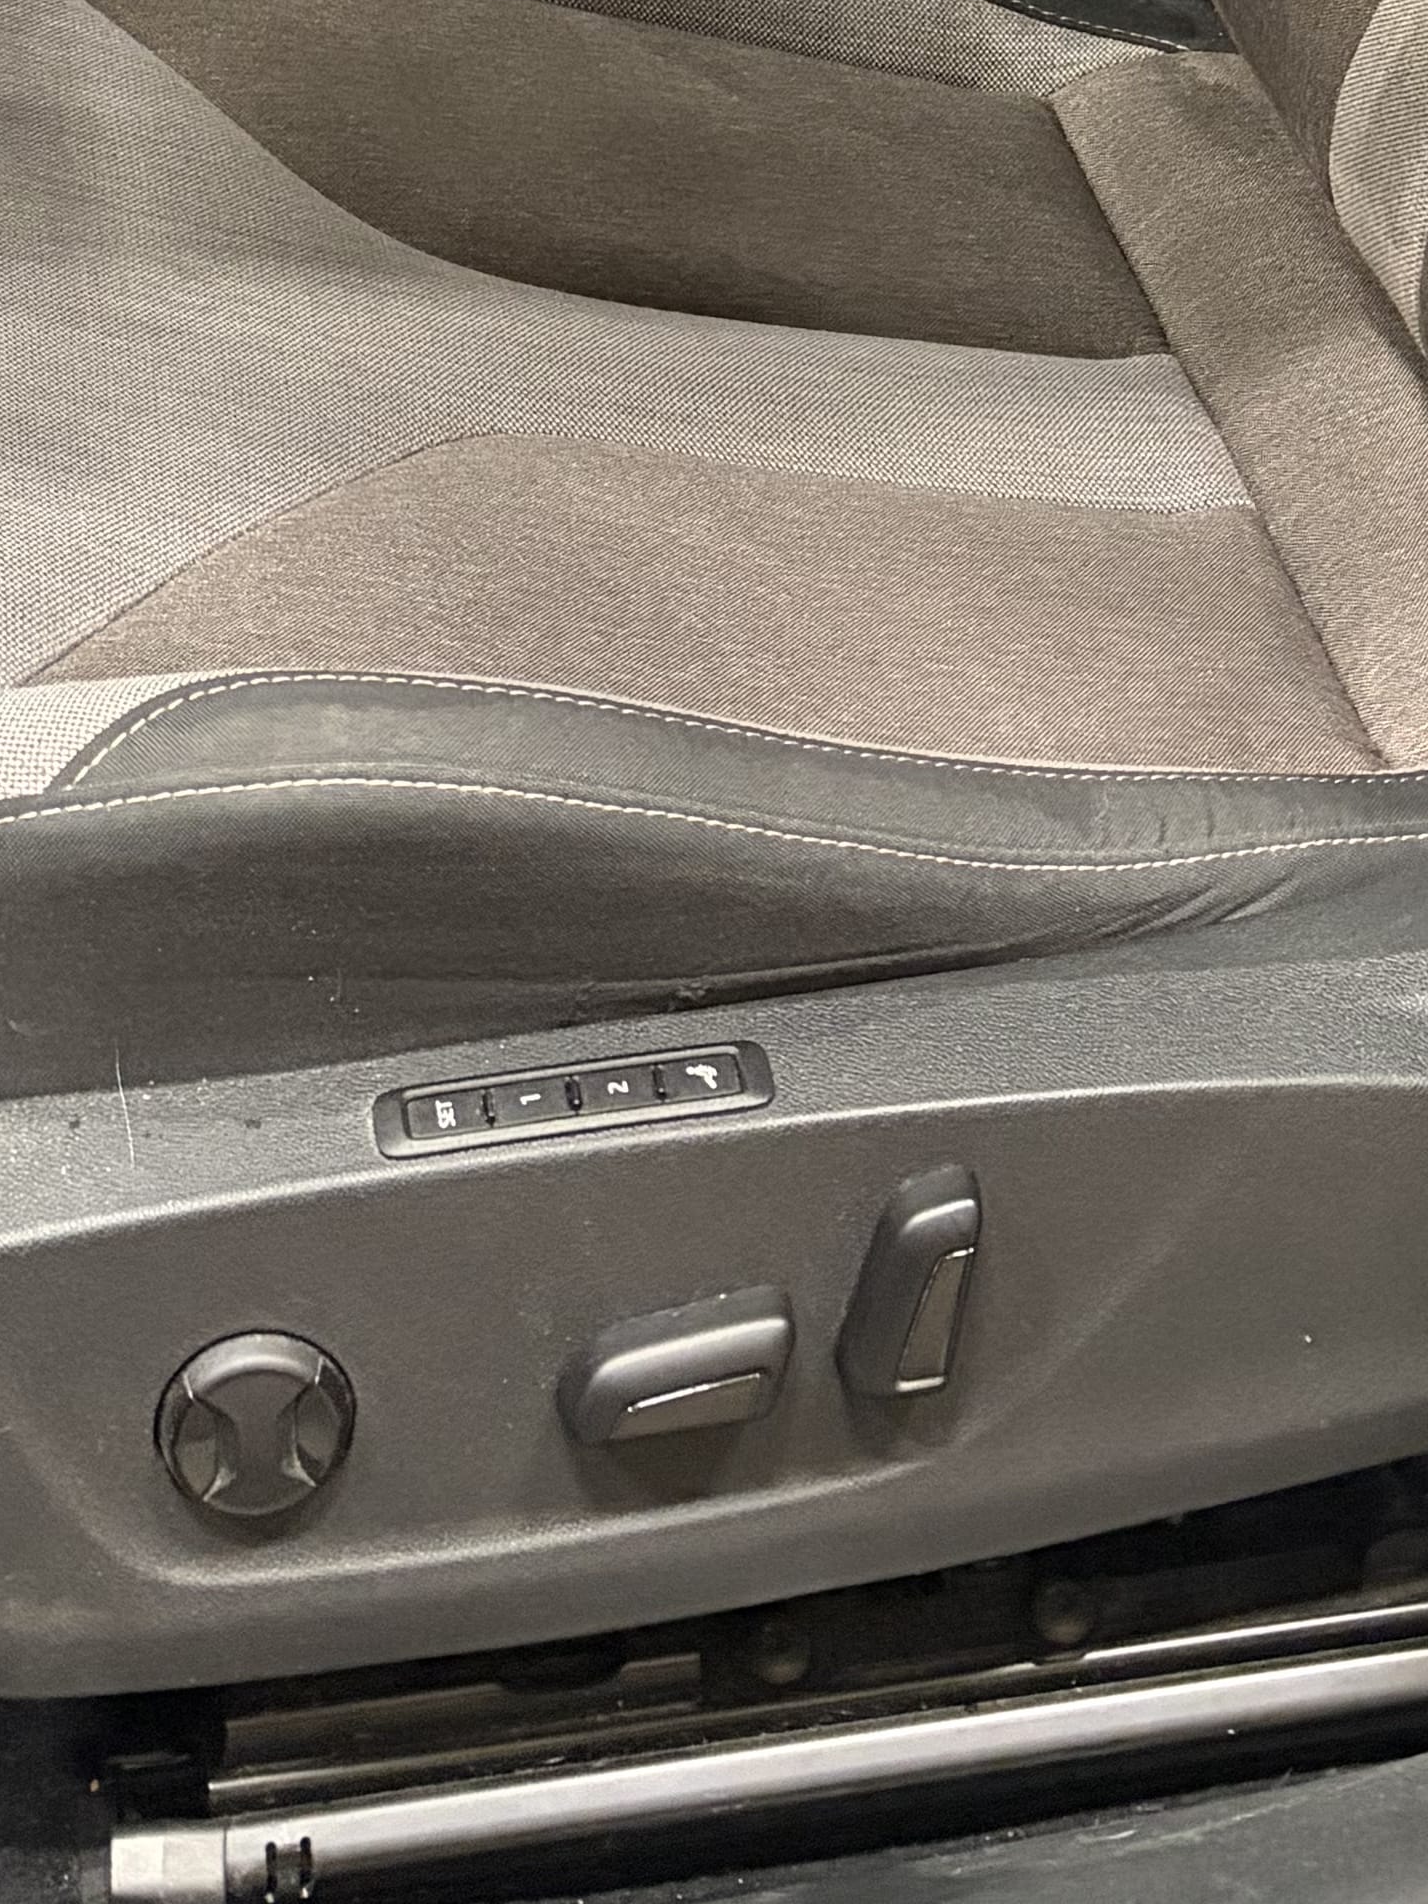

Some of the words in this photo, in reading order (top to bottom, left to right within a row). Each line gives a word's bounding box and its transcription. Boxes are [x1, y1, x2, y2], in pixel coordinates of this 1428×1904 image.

[607, 1080, 630, 1095] 2
[519, 1092, 542, 1106] 1
[435, 1099, 457, 1129] SET
